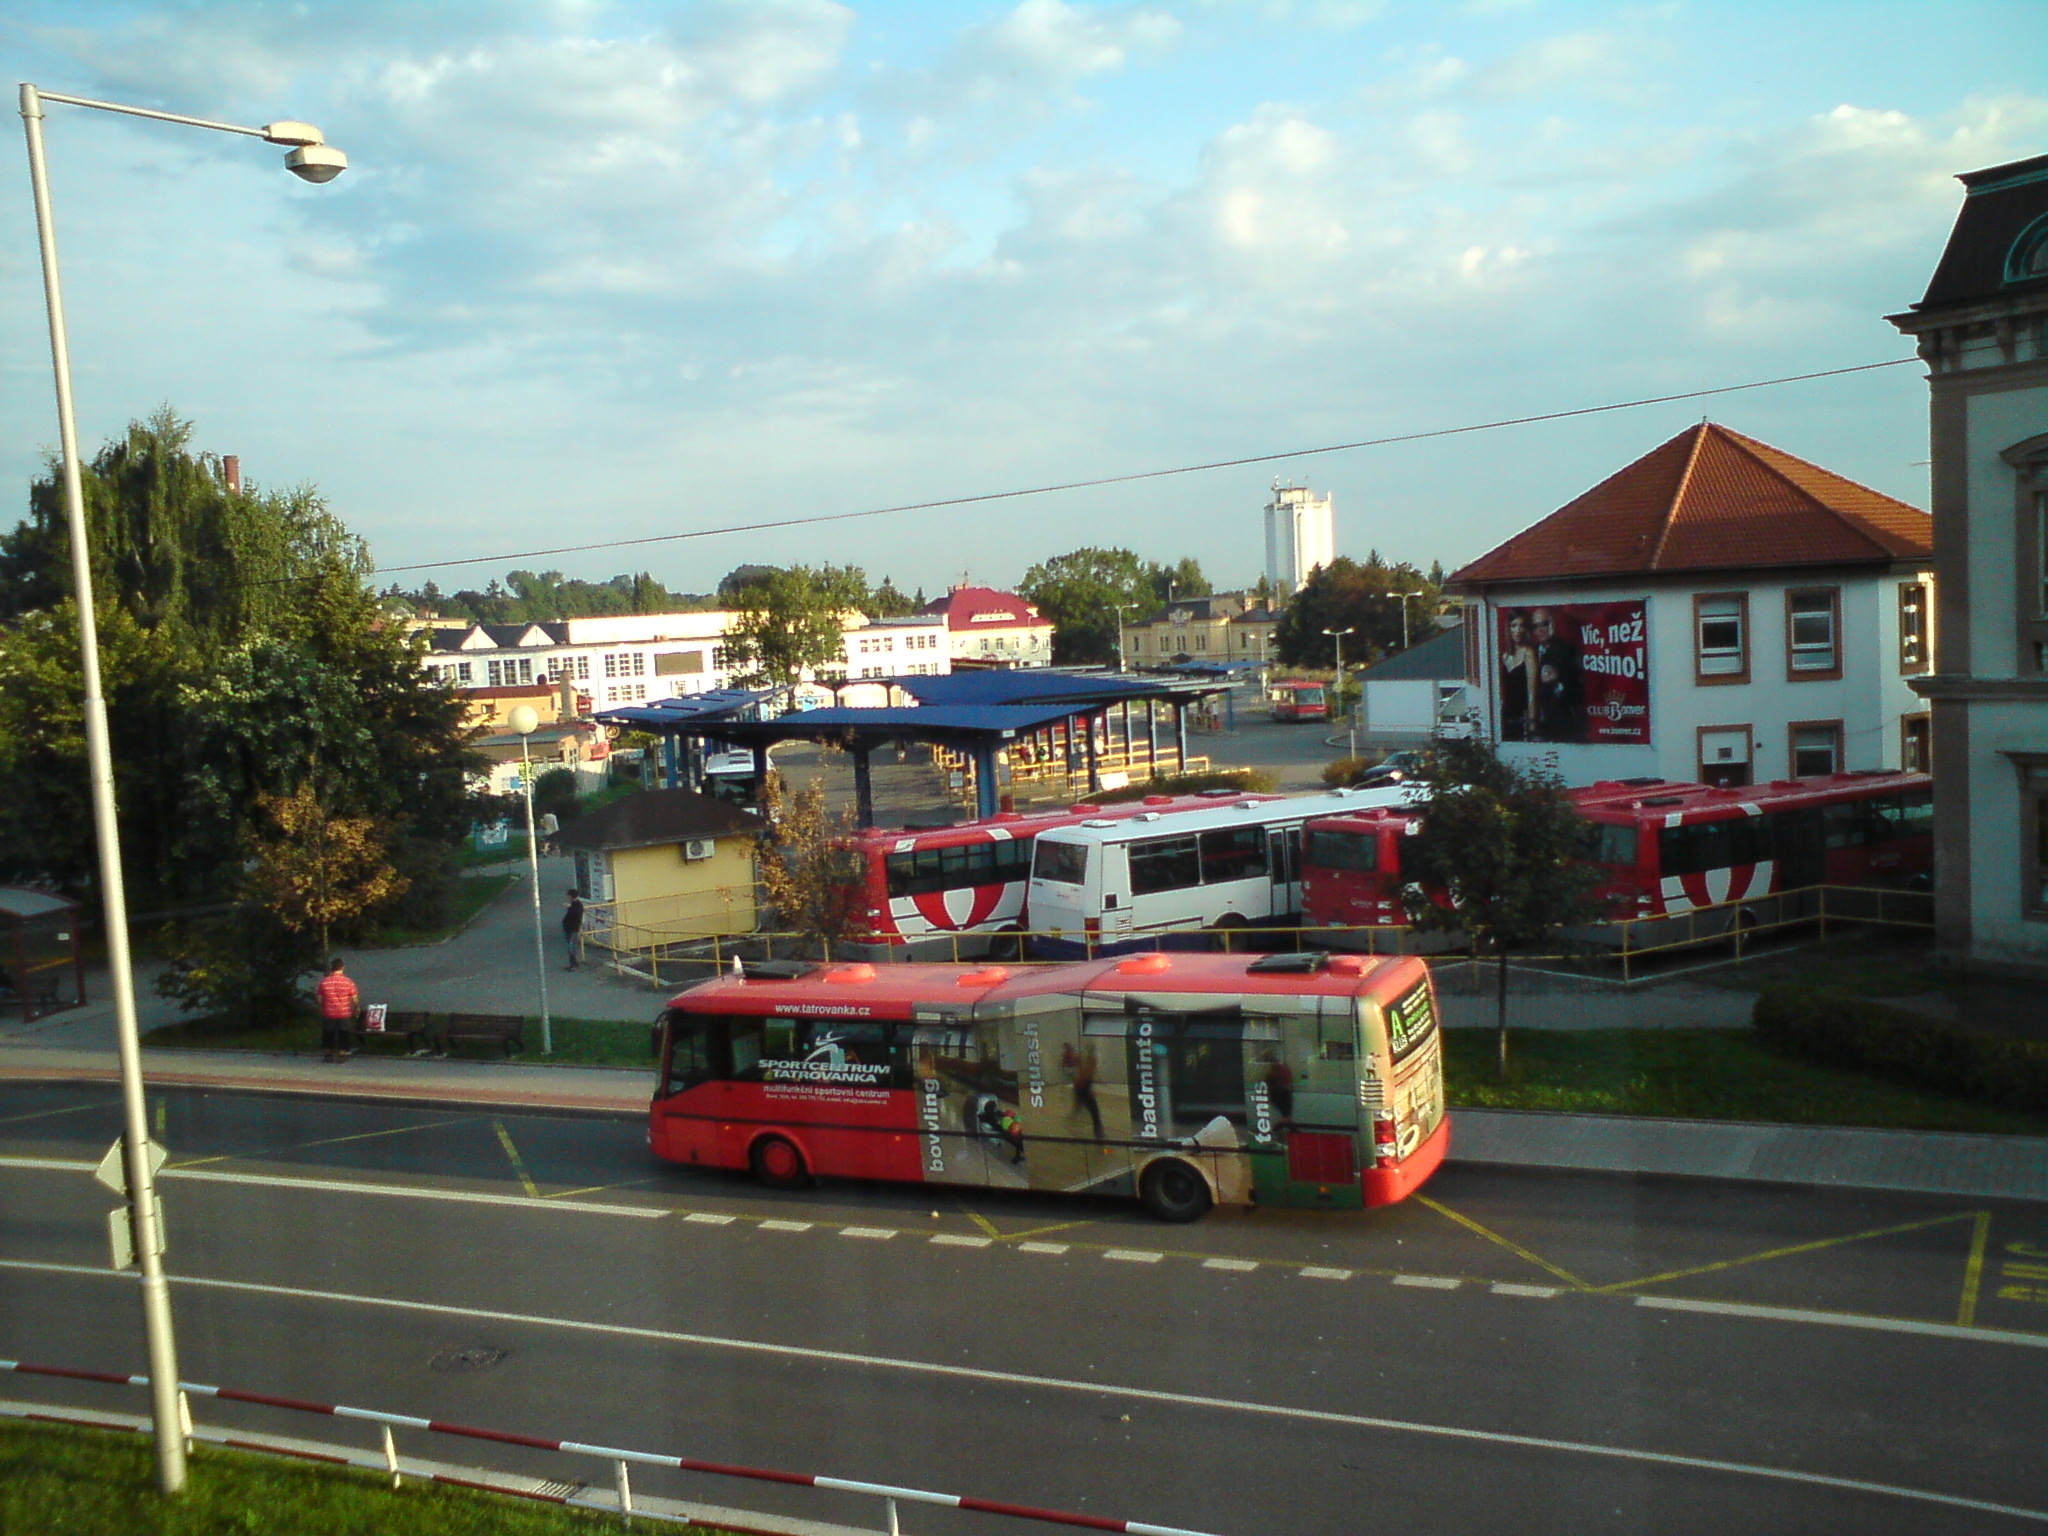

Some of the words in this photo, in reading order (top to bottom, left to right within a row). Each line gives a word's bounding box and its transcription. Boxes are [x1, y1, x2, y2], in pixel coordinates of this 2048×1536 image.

[1608, 611, 1643, 643] než
[1583, 647, 1644, 679] casino!
[1587, 705, 1610, 716] CLUB
[775, 1004, 871, 1016] www.tatrovanka.cz
[772, 1069, 877, 1083] TATROVANKA
[1023, 1022, 1044, 1108] squash
[855, 1090, 890, 1099] centrum
[1249, 1080, 1272, 1143] tenis
